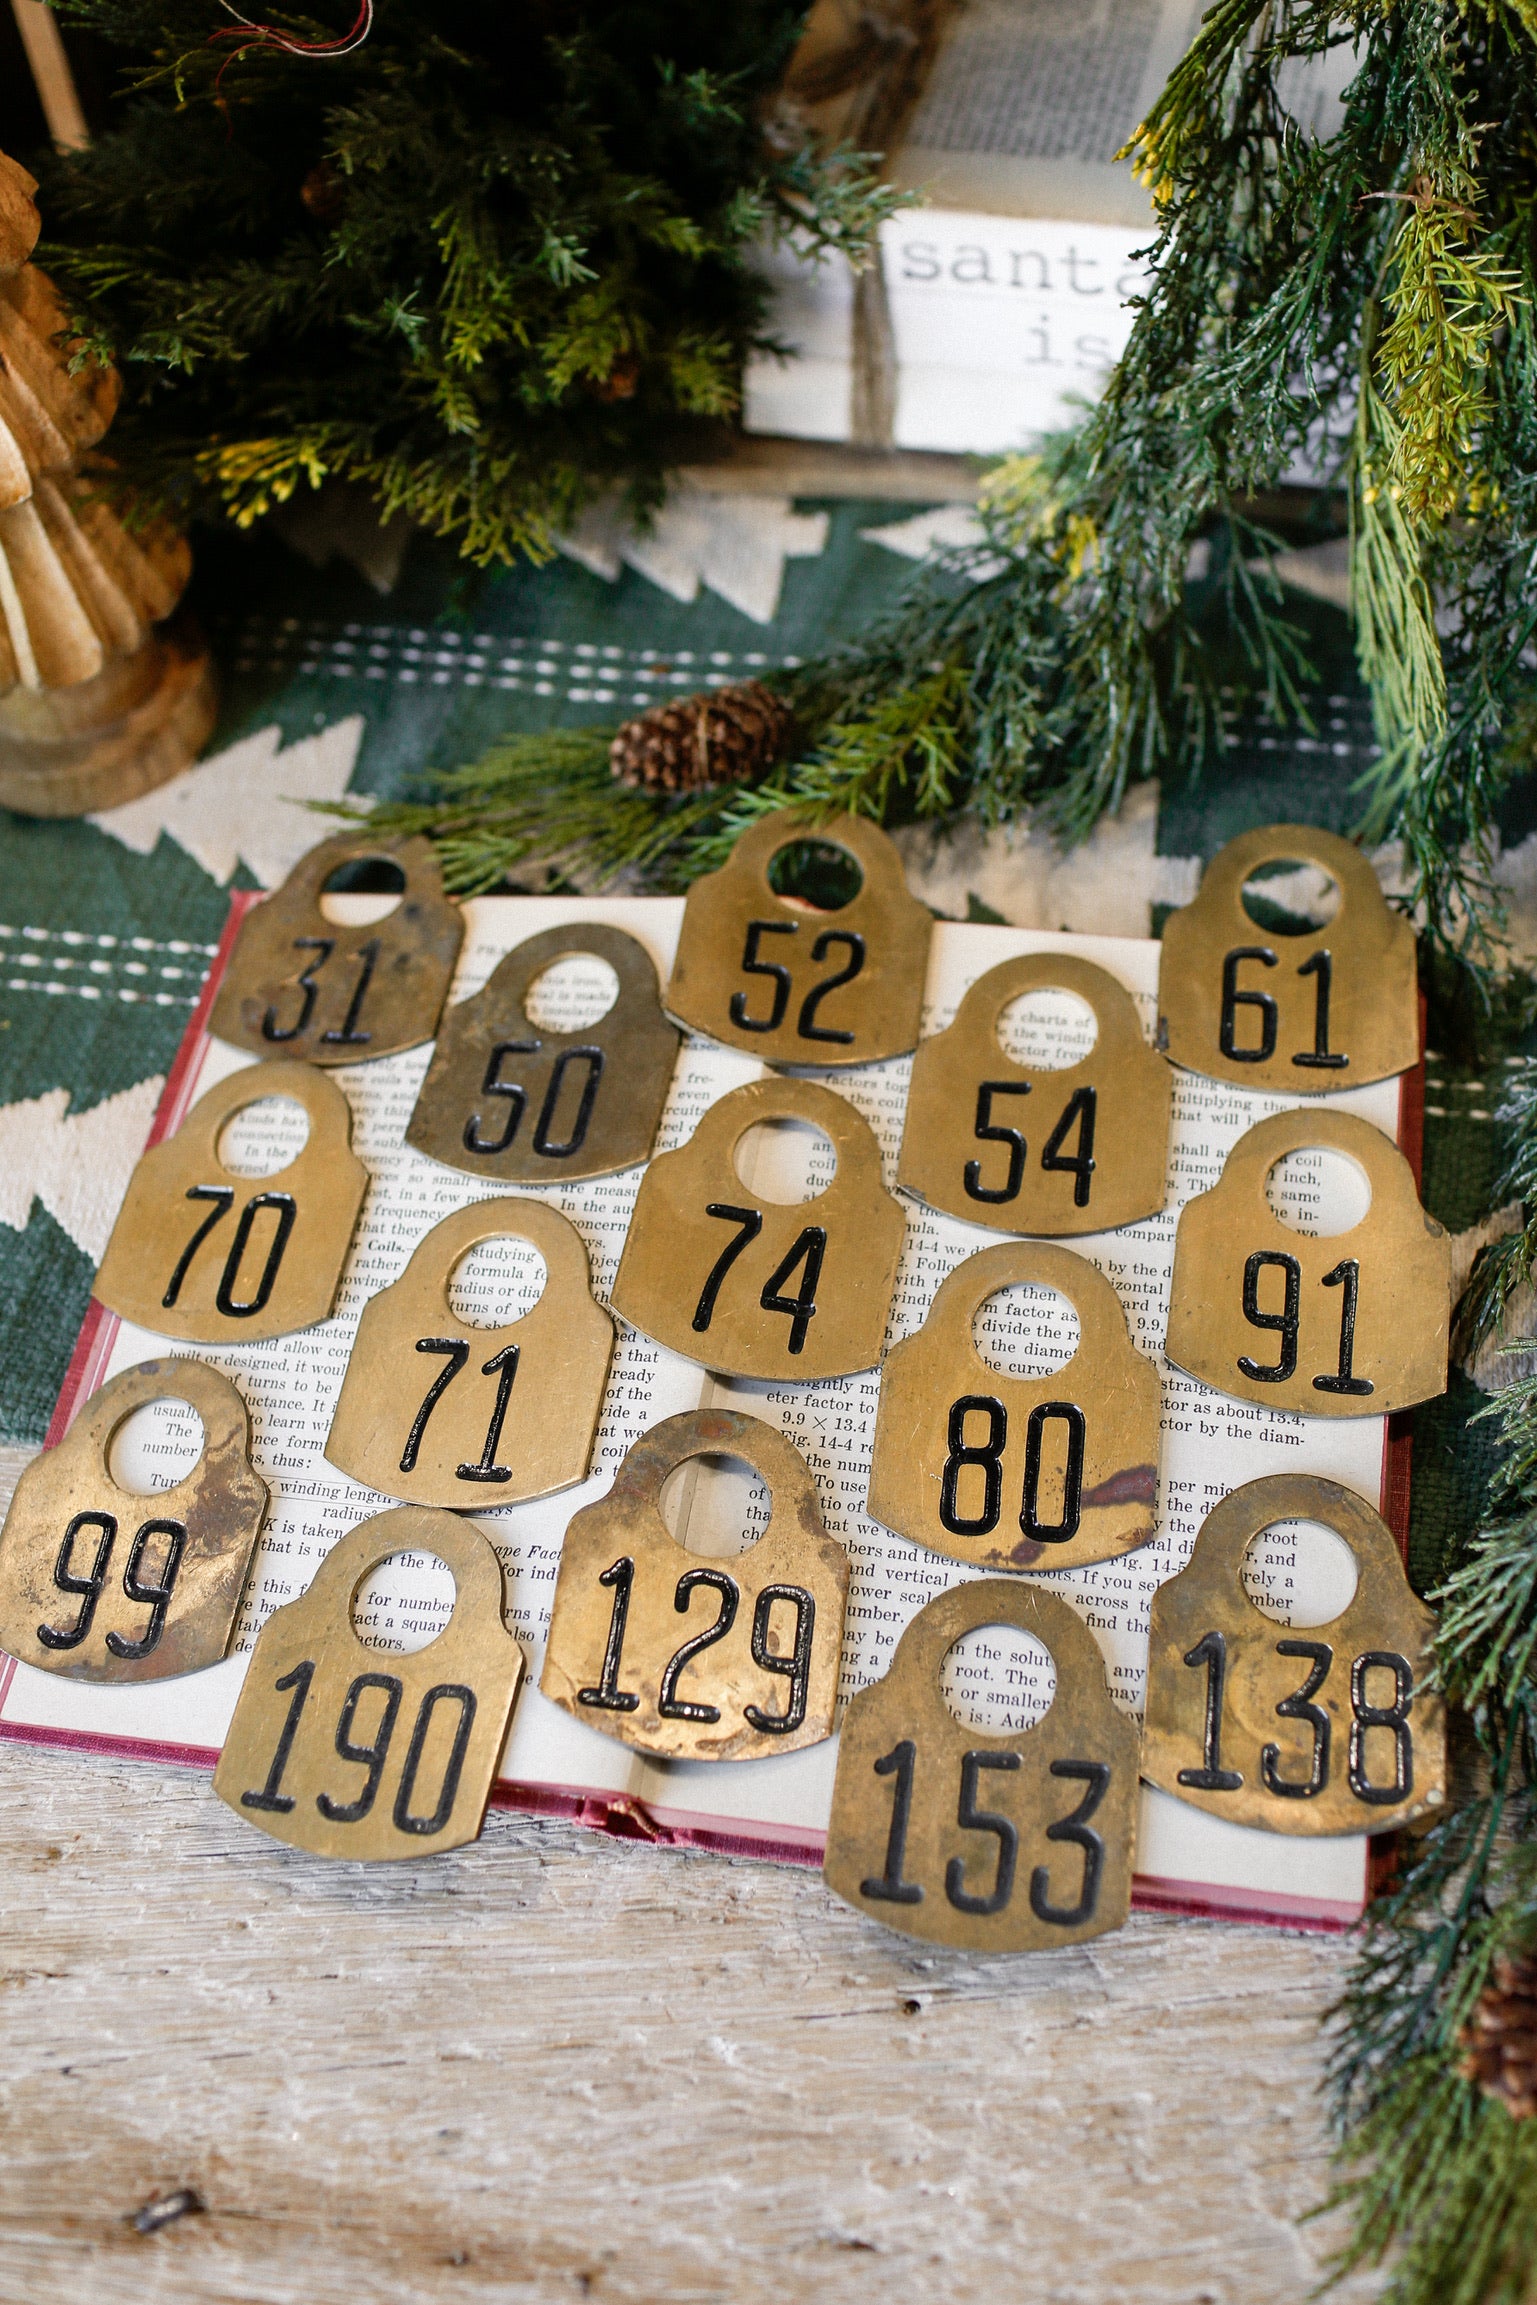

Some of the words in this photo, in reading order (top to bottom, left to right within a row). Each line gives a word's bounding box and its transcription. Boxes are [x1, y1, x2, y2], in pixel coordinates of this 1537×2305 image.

[902, 239, 1154, 297] santa
[1025, 314, 1112, 371] is
[728, 920, 866, 1045] 52
[261, 938, 385, 1046] 31
[1218, 946, 1350, 1069] 61
[1014, 1027, 1038, 1039] the
[1005, 1043, 1049, 1057] factor
[688, 1073, 714, 1084] fre-
[825, 1072, 877, 1089] factors
[463, 1040, 607, 1160] 50
[678, 1090, 710, 1100] even
[850, 1094, 873, 1105] the
[1171, 1110, 1201, 1122] that
[1211, 1113, 1239, 1126] will
[963, 1080, 1097, 1207] 54
[1173, 1143, 1209, 1157] shall
[809, 1158, 835, 1170] coil
[1295, 1155, 1322, 1167] coil
[409, 1174, 423, 1183] so
[432, 1174, 470, 1186] small
[1284, 1171, 1321, 1187] inch,
[400, 1188, 413, 1200] in
[418, 1192, 426, 1200] a
[433, 1190, 460, 1203] few
[1280, 1192, 1321, 1203] same
[373, 1204, 445, 1221] frequency
[560, 1198, 576, 1211] In
[583, 1200, 606, 1212] the
[1298, 1208, 1320, 1222] in-
[356, 1222, 385, 1233] that
[391, 1223, 421, 1238] they
[162, 1185, 297, 1317] 70
[471, 1246, 536, 1263] studying
[908, 1239, 938, 1253] 14-4
[945, 1245, 965, 1256] we
[355, 1257, 401, 1270] rather
[466, 1263, 523, 1280] formula
[1108, 1260, 1127, 1275] by
[1133, 1262, 1157, 1276] the
[690, 1203, 828, 1356] 74
[337, 1290, 360, 1303] the
[448, 1281, 494, 1295] radius
[498, 1287, 514, 1297] or
[1022, 1287, 1057, 1302] then
[449, 1300, 489, 1313] turns
[495, 1302, 512, 1315] of
[1005, 1303, 1054, 1320] factor
[1061, 1311, 1078, 1323] as
[982, 1318, 1031, 1336] divide
[1036, 1322, 1061, 1339] the
[1137, 1317, 1164, 1334] 9.9,
[1236, 1249, 1375, 1396] 91
[284, 1341, 322, 1355] allow
[991, 1338, 1016, 1353] the
[205, 1353, 221, 1365] or
[224, 1352, 290, 1374] designed,
[295, 1360, 307, 1373] it
[628, 1348, 660, 1363] that
[1008, 1363, 1053, 1377] curve
[248, 1376, 286, 1391] turns
[294, 1379, 308, 1393] to
[316, 1380, 332, 1394] be
[606, 1386, 623, 1399] of
[628, 1387, 652, 1401] the
[312, 1399, 325, 1412] It
[766, 1390, 799, 1405] eter
[804, 1394, 854, 1412] factor
[859, 1401, 874, 1414] to
[399, 1338, 521, 1485] 71
[639, 1410, 647, 1420] a
[1193, 1403, 1211, 1415] as
[1216, 1405, 1262, 1422] about
[1269, 1411, 1306, 1428] 13.4,
[250, 1414, 263, 1426] to
[268, 1415, 305, 1430] learn
[782, 1410, 805, 1425] 9.9
[835, 1417, 867, 1433] 13.4
[166, 1422, 192, 1438] The
[625, 1429, 645, 1439] we
[1199, 1420, 1219, 1438] by
[1227, 1424, 1252, 1440] the
[1259, 1428, 1305, 1446] diam-
[780, 1430, 811, 1447] Fig.
[819, 1435, 853, 1451] 14-4
[144, 1441, 197, 1457] number
[602, 1445, 628, 1458] coil
[272, 1453, 312, 1469] thus:
[806, 1453, 830, 1469] the
[938, 1395, 1087, 1544] 80
[280, 1480, 341, 1499] winding
[814, 1473, 835, 1490] To
[841, 1481, 866, 1494] use
[1168, 1480, 1196, 1495] per
[749, 1487, 766, 1501] of
[847, 1500, 865, 1513] of
[1167, 1499, 1192, 1513] the
[262, 1517, 278, 1532] K
[282, 1520, 295, 1533] is
[302, 1523, 343, 1540] taken
[857, 1523, 879, 1537] we
[1169, 1519, 1195, 1534] the
[1263, 1531, 1298, 1546] root
[261, 1538, 291, 1554] that
[298, 1542, 311, 1556] is
[888, 1548, 917, 1562] and
[401, 1553, 424, 1568] the
[1265, 1553, 1295, 1568] and
[501, 1563, 524, 1578] for
[531, 1565, 556, 1581] ind
[885, 1569, 949, 1587] vertical
[37, 1510, 188, 1661] 99
[264, 1579, 291, 1595] this
[1082, 1569, 1098, 1585] If
[1102, 1577, 1132, 1593] you
[1285, 1578, 1294, 1588] a
[368, 1591, 391, 1607] for
[1075, 1593, 1129, 1610] across
[538, 1607, 552, 1622] is
[385, 1618, 394, 1628] a
[1086, 1612, 1117, 1630] find
[1127, 1618, 1150, 1634] the
[577, 1556, 816, 1735] 129
[876, 1630, 894, 1646] be
[869, 1654, 879, 1666] a
[975, 1643, 1001, 1661] the
[1010, 1650, 1051, 1667] solut
[955, 1666, 994, 1682] root.
[1005, 1668, 1038, 1688] The
[1113, 1665, 1145, 1682] any
[961, 1689, 979, 1701] or
[987, 1691, 1050, 1711] smaller
[969, 1708, 991, 1725] is:
[1001, 1714, 1036, 1731] Add
[1177, 1631, 1414, 1805] 138
[240, 1661, 478, 1836] 190
[860, 1740, 1111, 1927] 153
